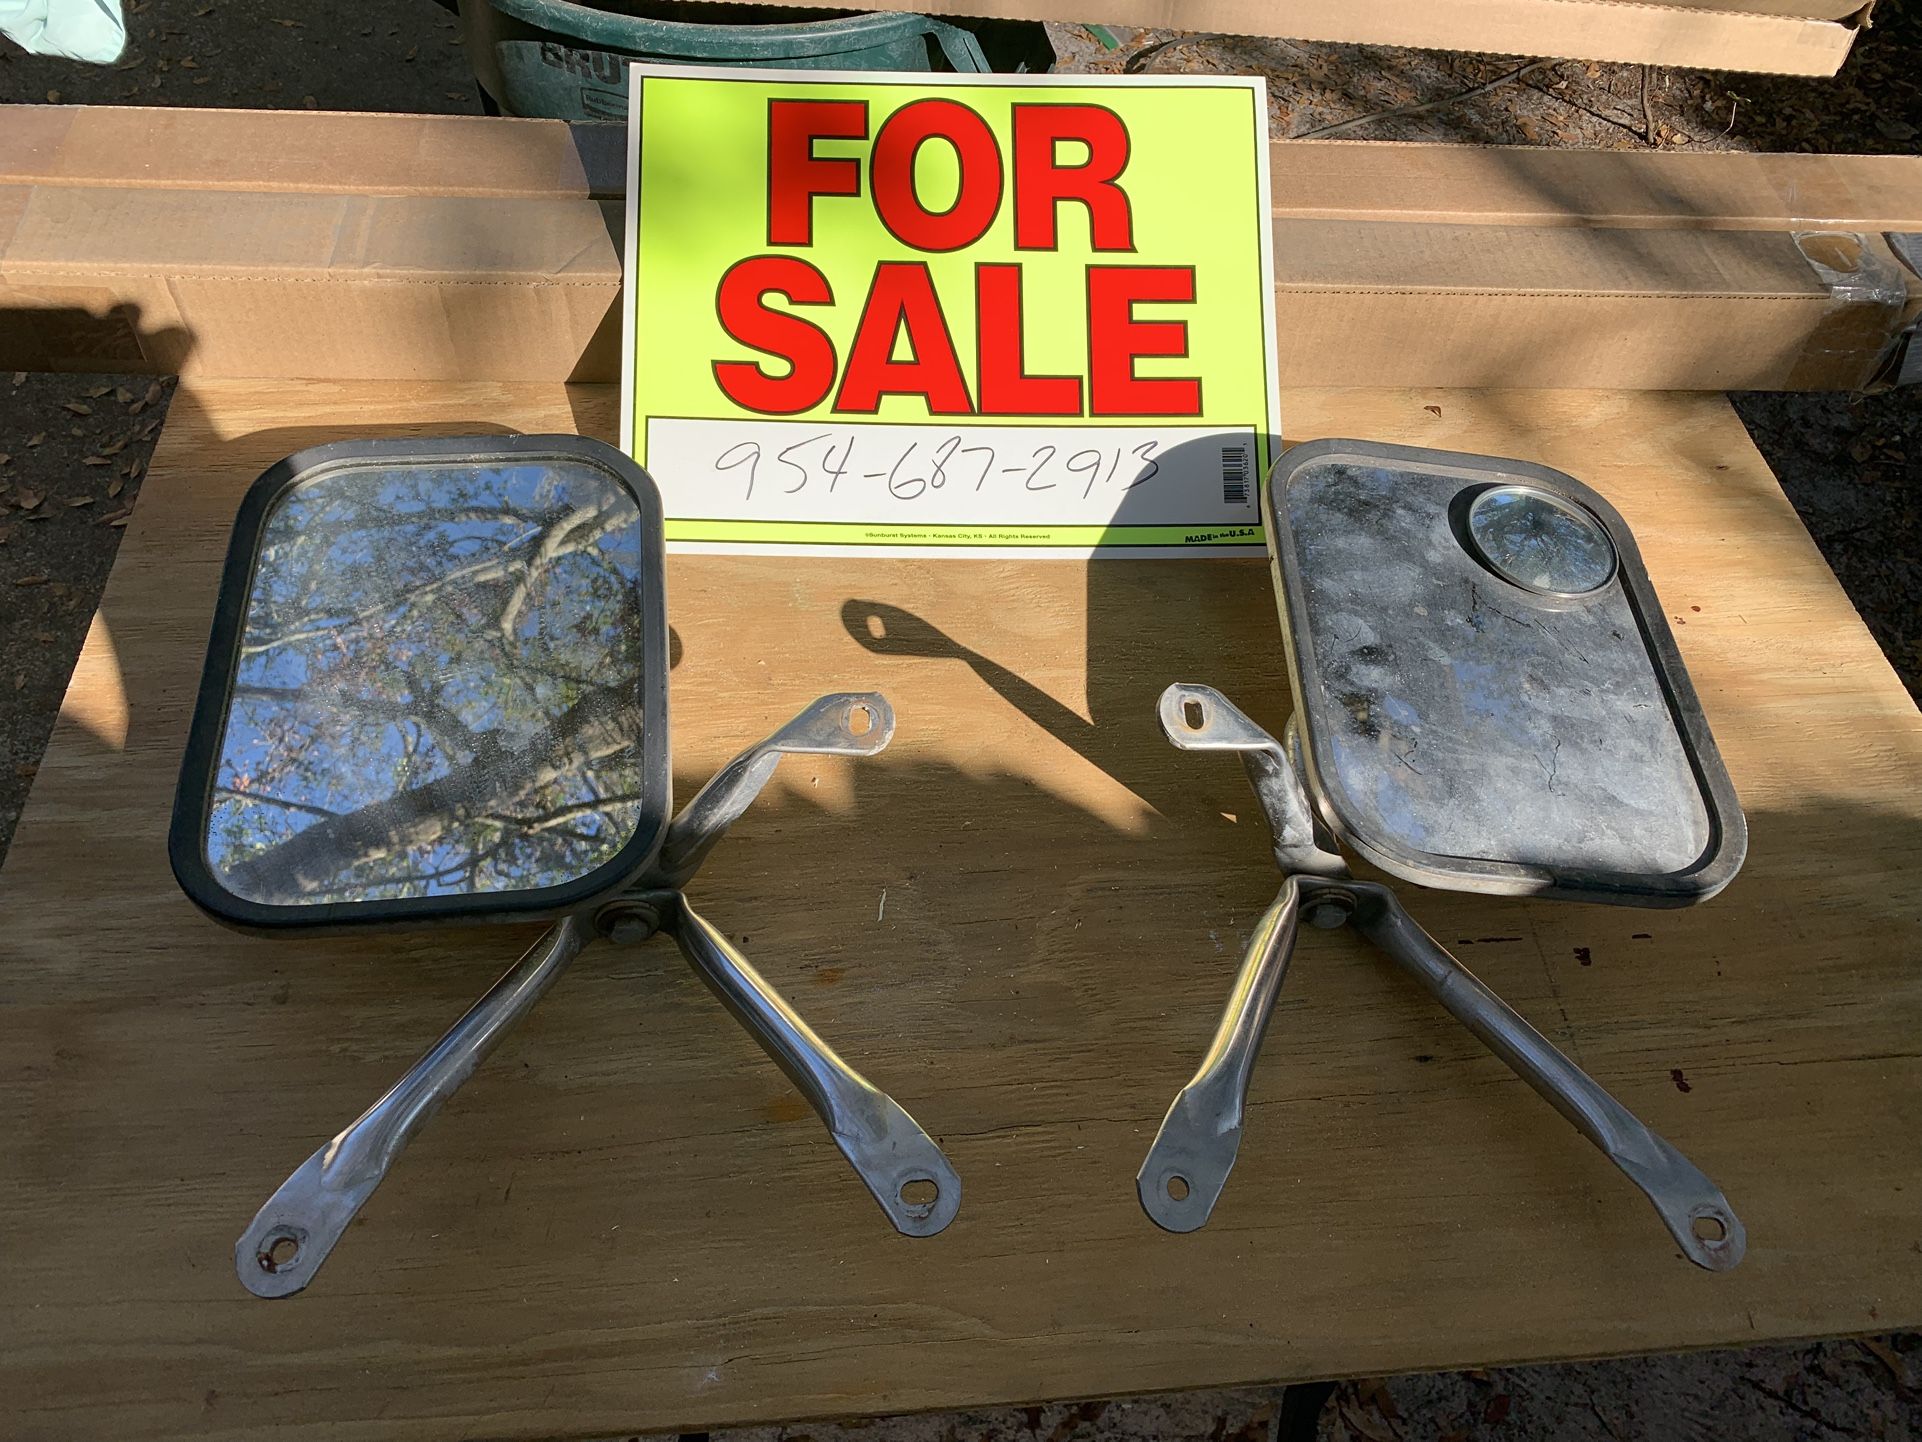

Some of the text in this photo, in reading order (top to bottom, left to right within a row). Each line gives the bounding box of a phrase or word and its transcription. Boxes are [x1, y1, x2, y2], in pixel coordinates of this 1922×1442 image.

[540, 41, 640, 85] BRU
[767, 97, 1138, 254] FOR
[711, 254, 1203, 417] SALE
[714, 433, 1159, 501] 954-687-2913
[1184, 534, 1213, 543] MADE
